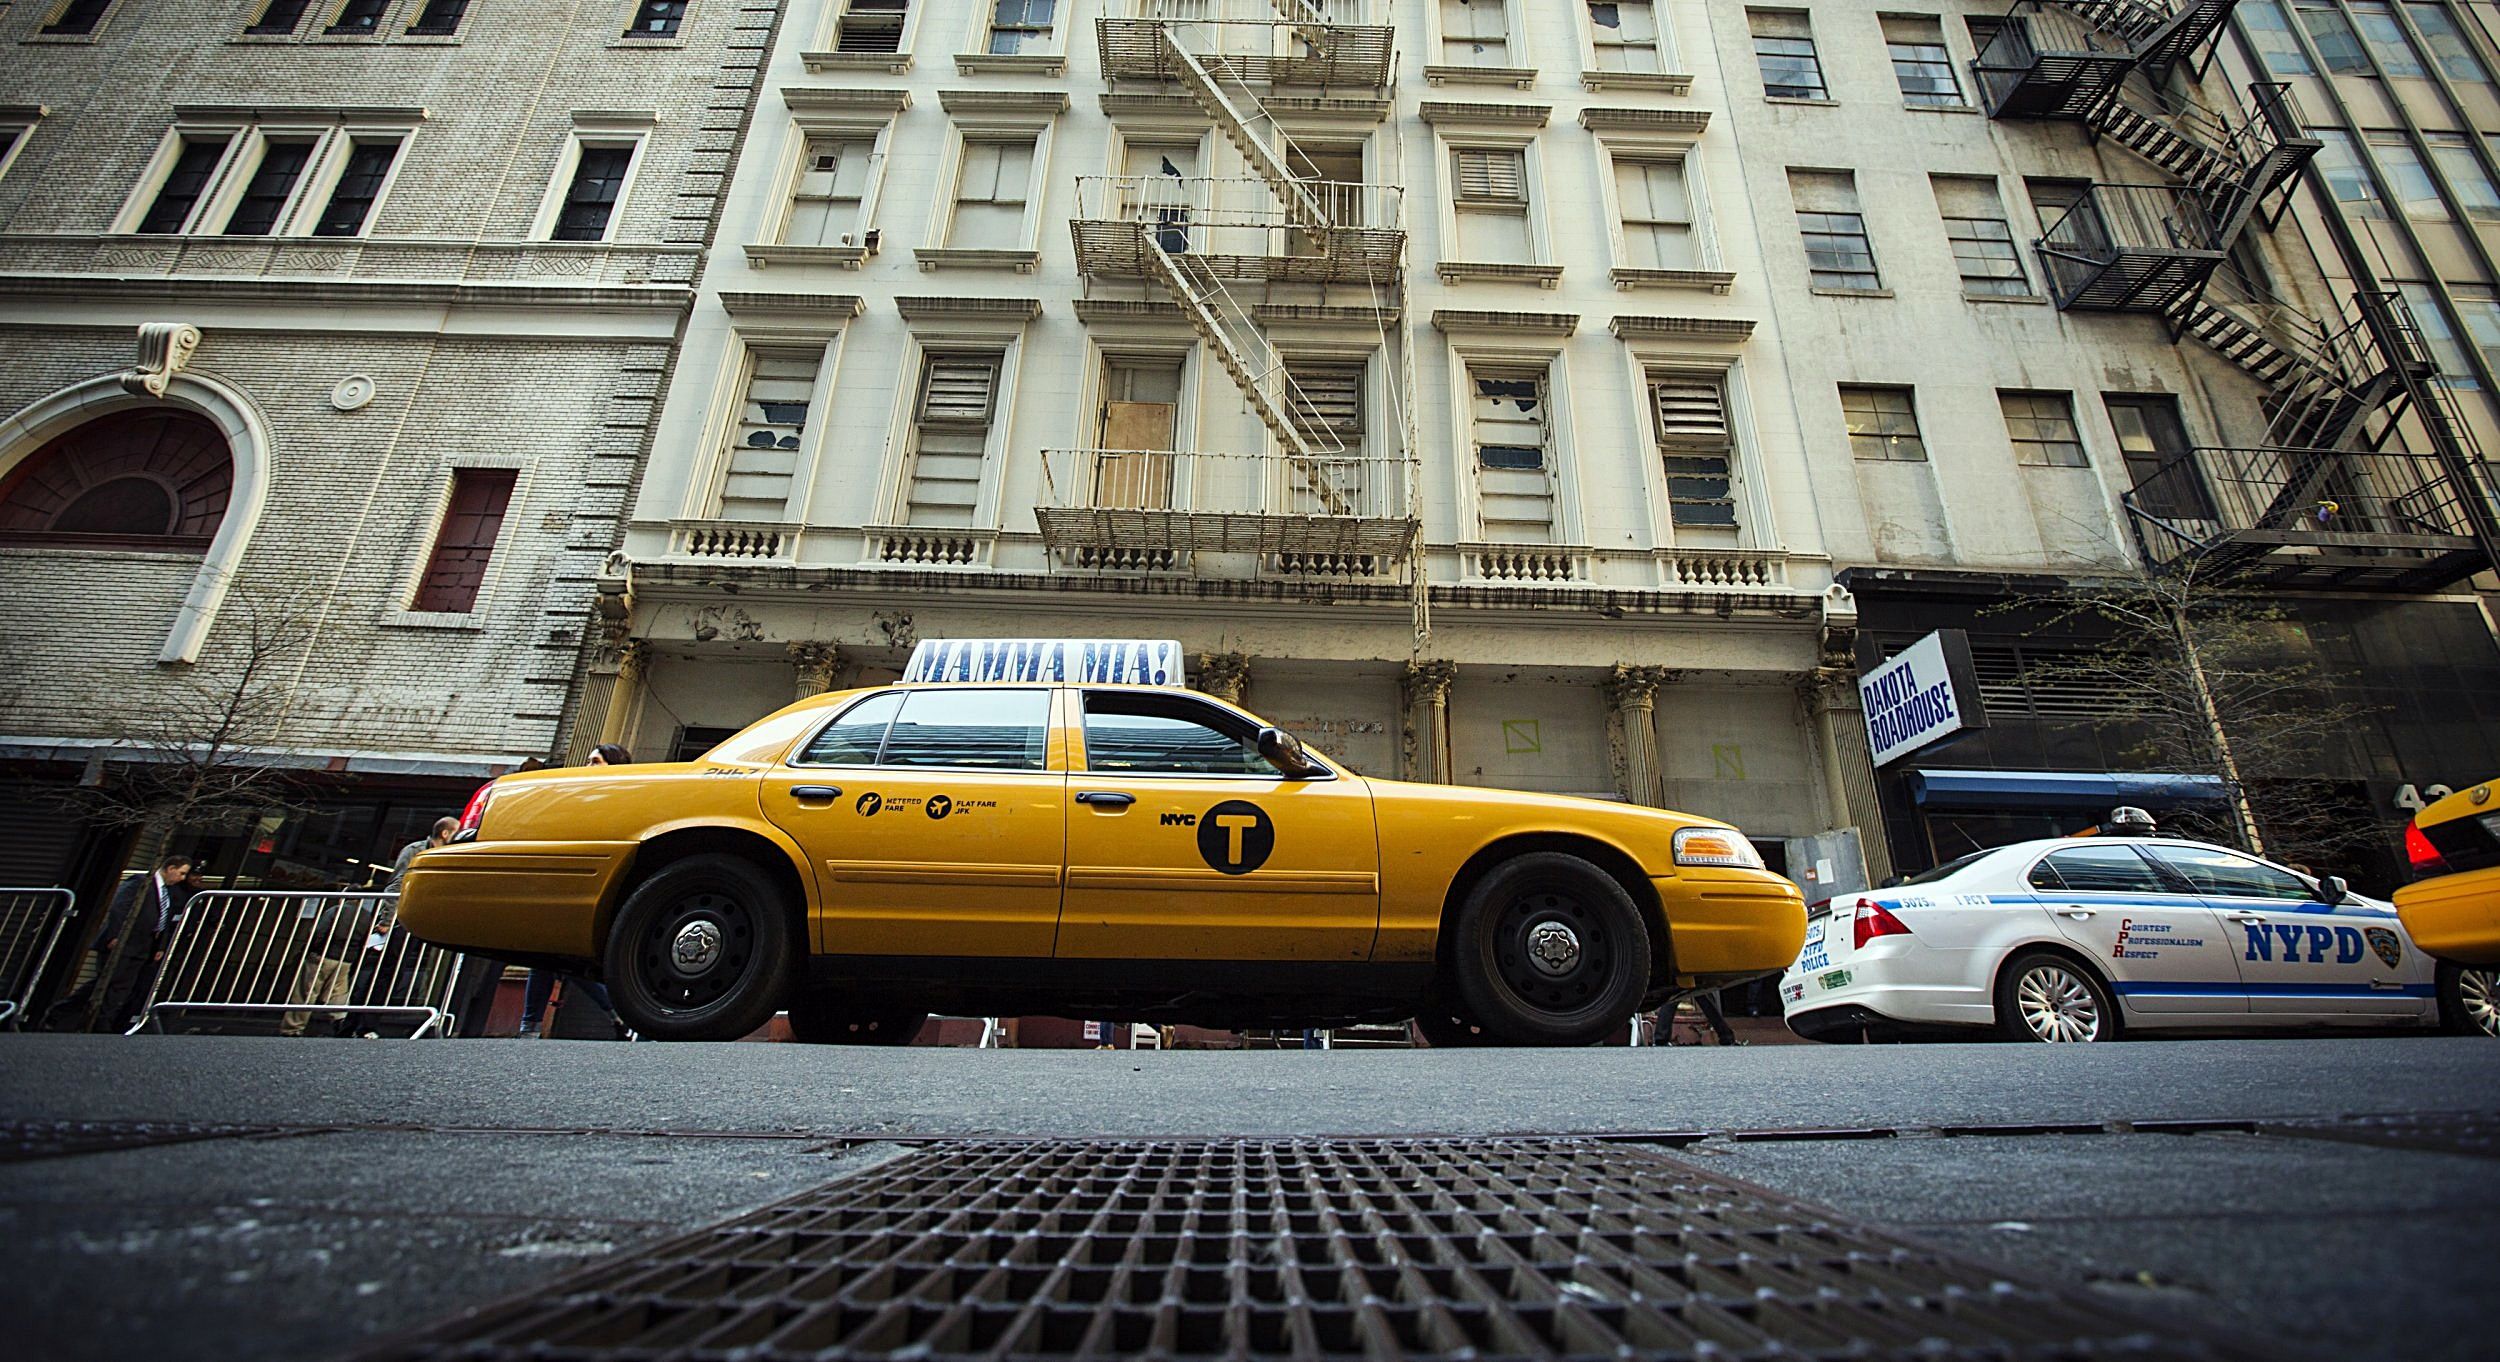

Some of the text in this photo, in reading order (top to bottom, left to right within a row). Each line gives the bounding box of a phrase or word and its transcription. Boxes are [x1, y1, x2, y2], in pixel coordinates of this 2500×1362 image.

[911, 641, 1169, 686] MAMMA MIA!
[1863, 661, 1918, 719] DAKOTA
[1870, 681, 1954, 754] ROADHOUSE
[1160, 813, 1257, 865] NYC T
[2117, 931, 2203, 946] PROFESSIONALISM
[2122, 919, 2172, 932] COURTESY
[2245, 924, 2364, 964] NYPD
[1801, 953, 1829, 973] POLICE
[2112, 945, 2158, 958] RESPECT
